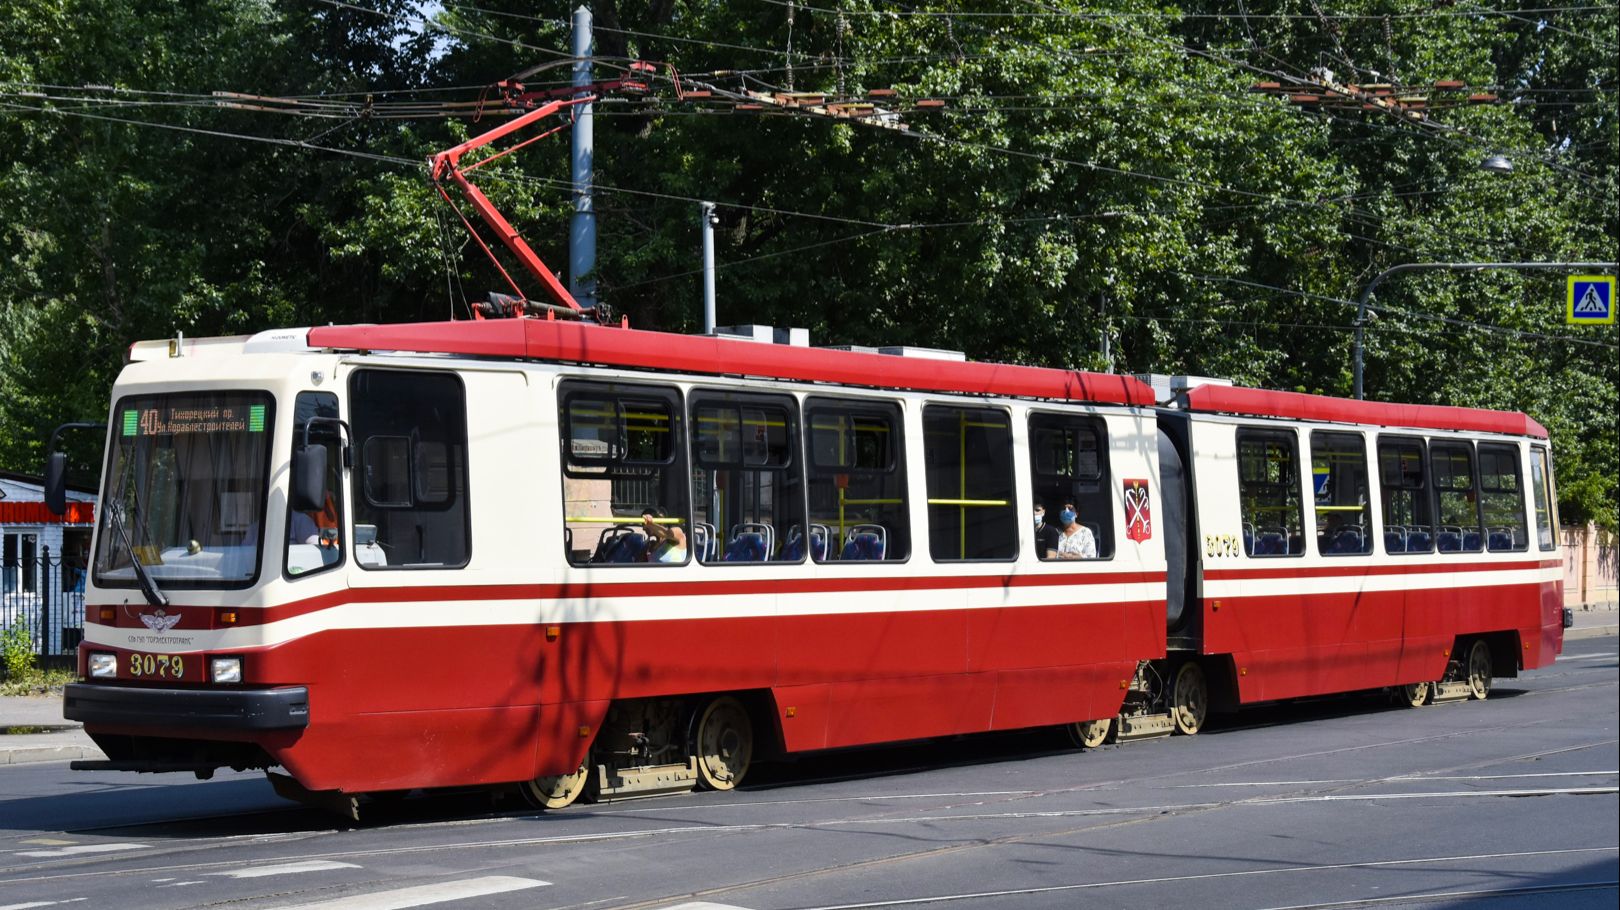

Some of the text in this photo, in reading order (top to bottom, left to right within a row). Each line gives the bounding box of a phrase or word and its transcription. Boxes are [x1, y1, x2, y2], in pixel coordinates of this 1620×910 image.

[140, 409, 158, 435] 40
[171, 408, 234, 420] Тихорецкий пр.
[1206, 535, 1239, 558] 3079
[130, 653, 184, 678] 3079
